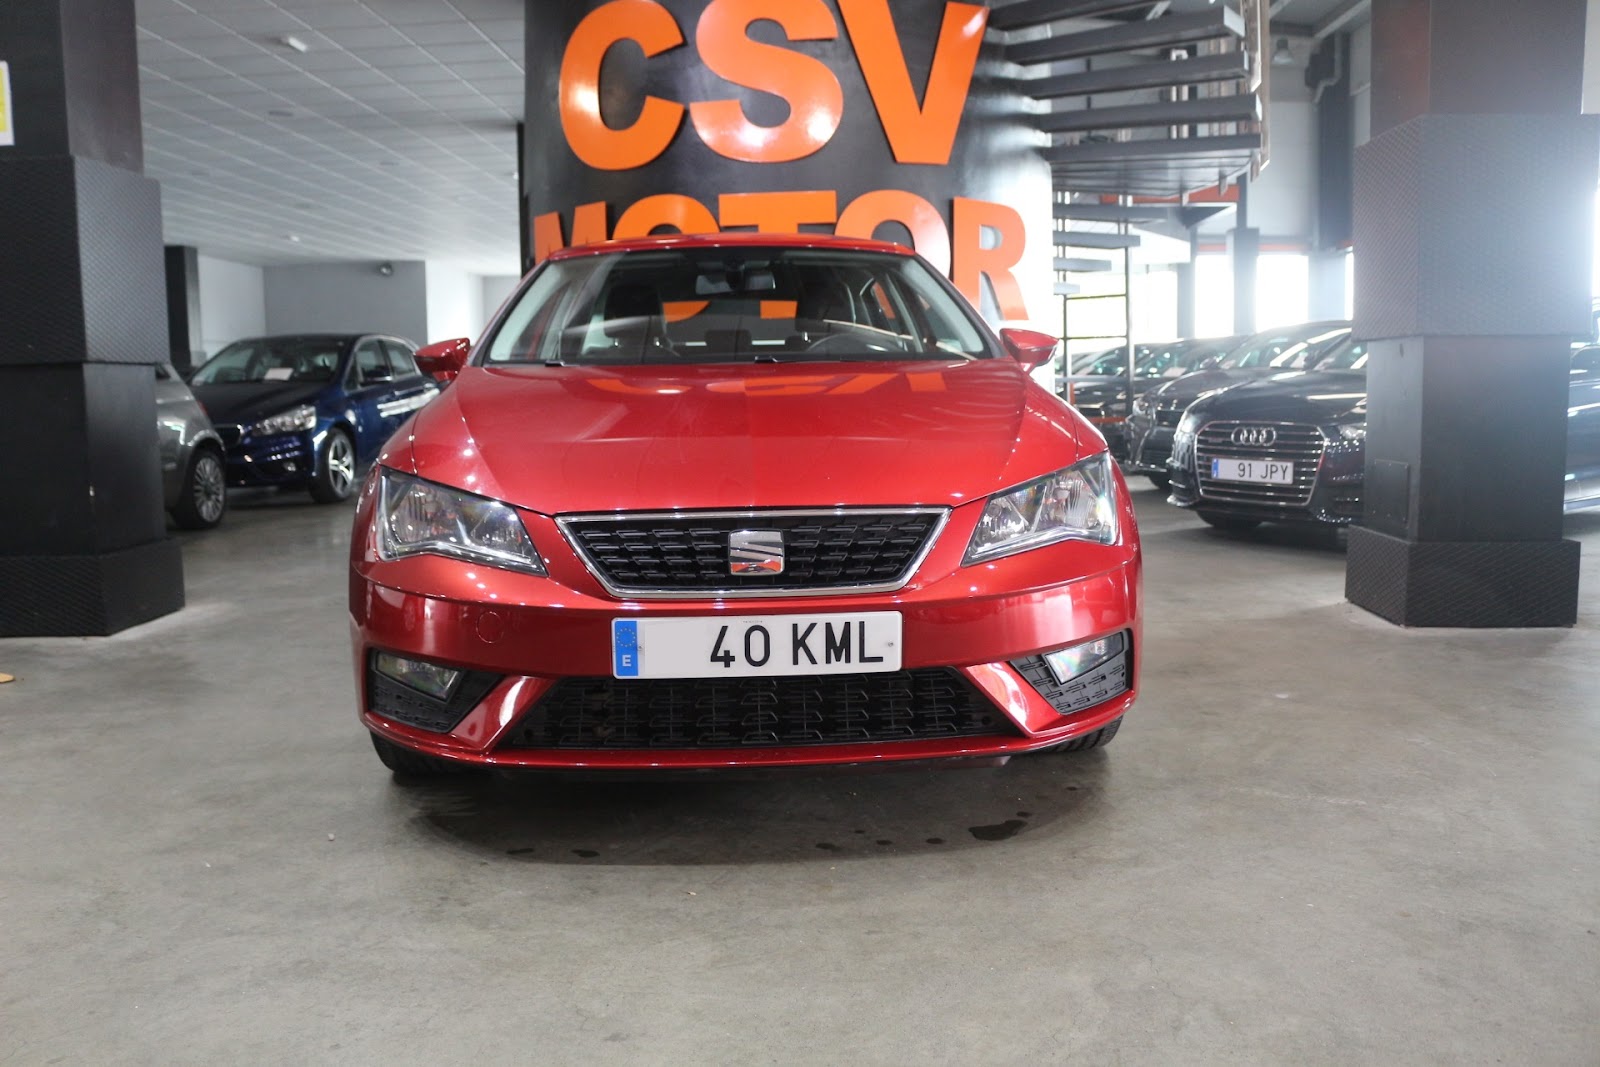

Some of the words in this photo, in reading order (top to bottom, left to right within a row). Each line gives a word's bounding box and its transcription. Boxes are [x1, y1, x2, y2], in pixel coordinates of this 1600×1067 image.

[559, 0, 990, 171] CSV
[1237, 462, 1252, 478] 91
[1260, 463, 1288, 480] JPY
[622, 654, 631, 667] E
[710, 624, 770, 668] 40
[792, 621, 884, 666] KML
